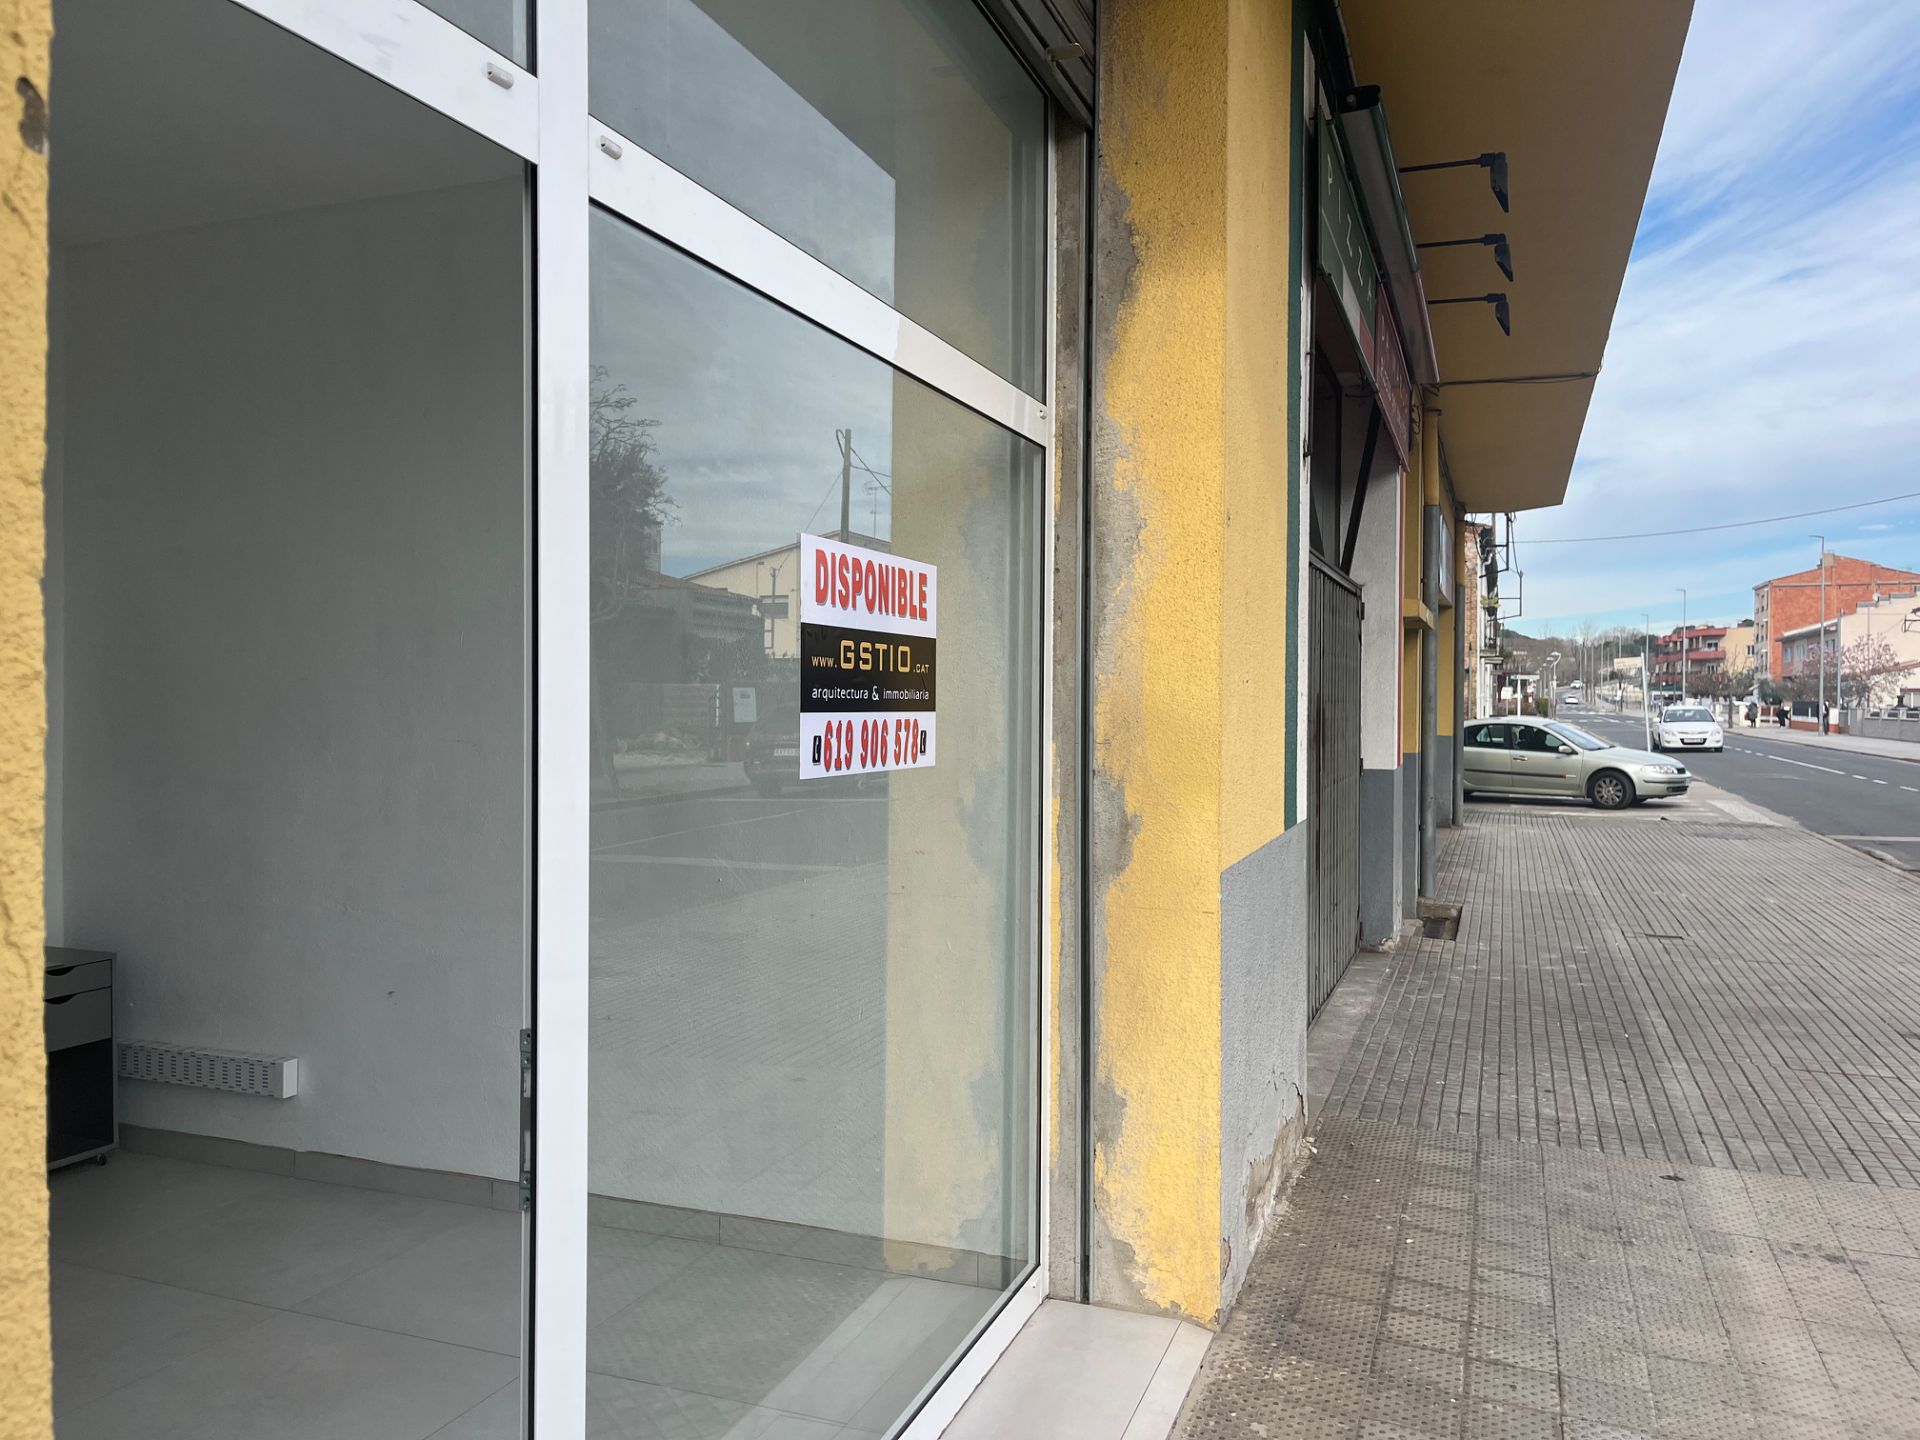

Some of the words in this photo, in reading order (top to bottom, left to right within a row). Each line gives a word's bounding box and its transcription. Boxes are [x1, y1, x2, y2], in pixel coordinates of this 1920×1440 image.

[815, 548, 928, 621] DISPONIBLE
[811, 686, 869, 701] arquitectura
[871, 685, 880, 700] &
[883, 688, 930, 700] immobiliaria
[823, 719, 854, 773] 619
[860, 718, 889, 769] 906
[893, 718, 920, 766] 578
